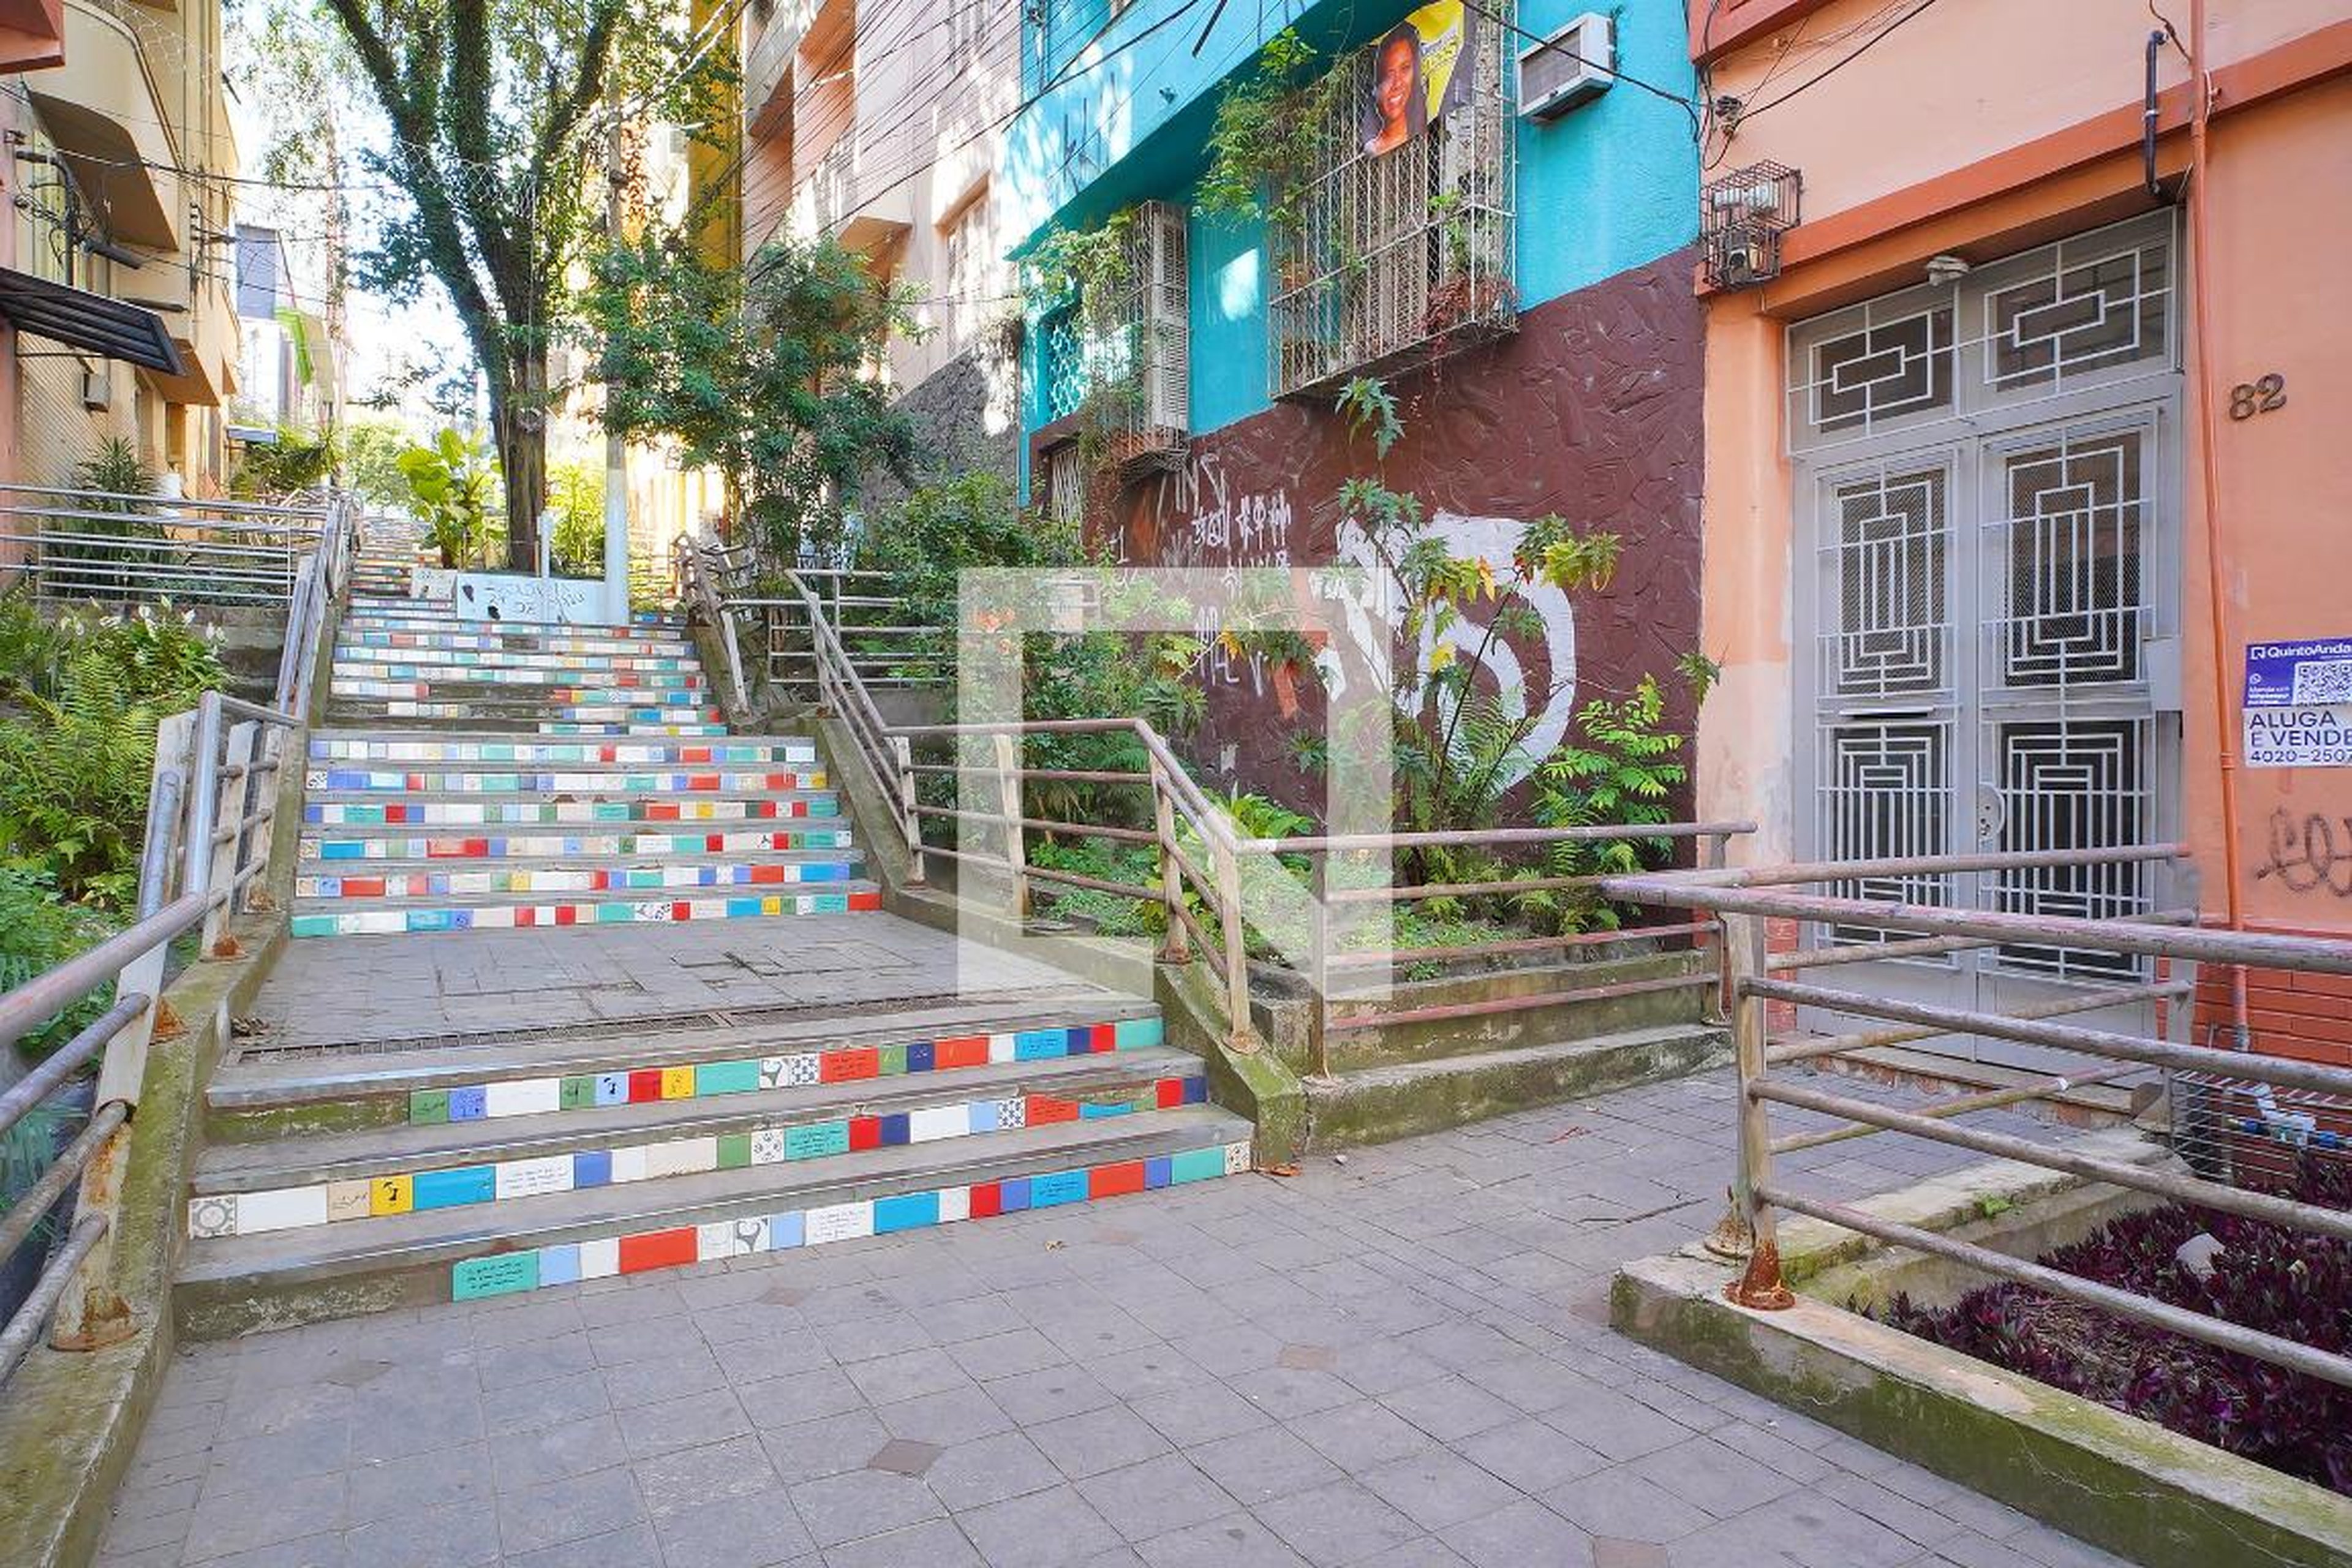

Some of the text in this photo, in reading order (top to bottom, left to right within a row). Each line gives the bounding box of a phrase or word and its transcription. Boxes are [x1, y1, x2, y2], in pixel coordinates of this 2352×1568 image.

[2230, 373, 2287, 421] 82
[2267, 644, 2352, 657] QuintoAnda
[2250, 710, 2336, 729] ALUGA
[2252, 729, 2352, 746] E VENDE
